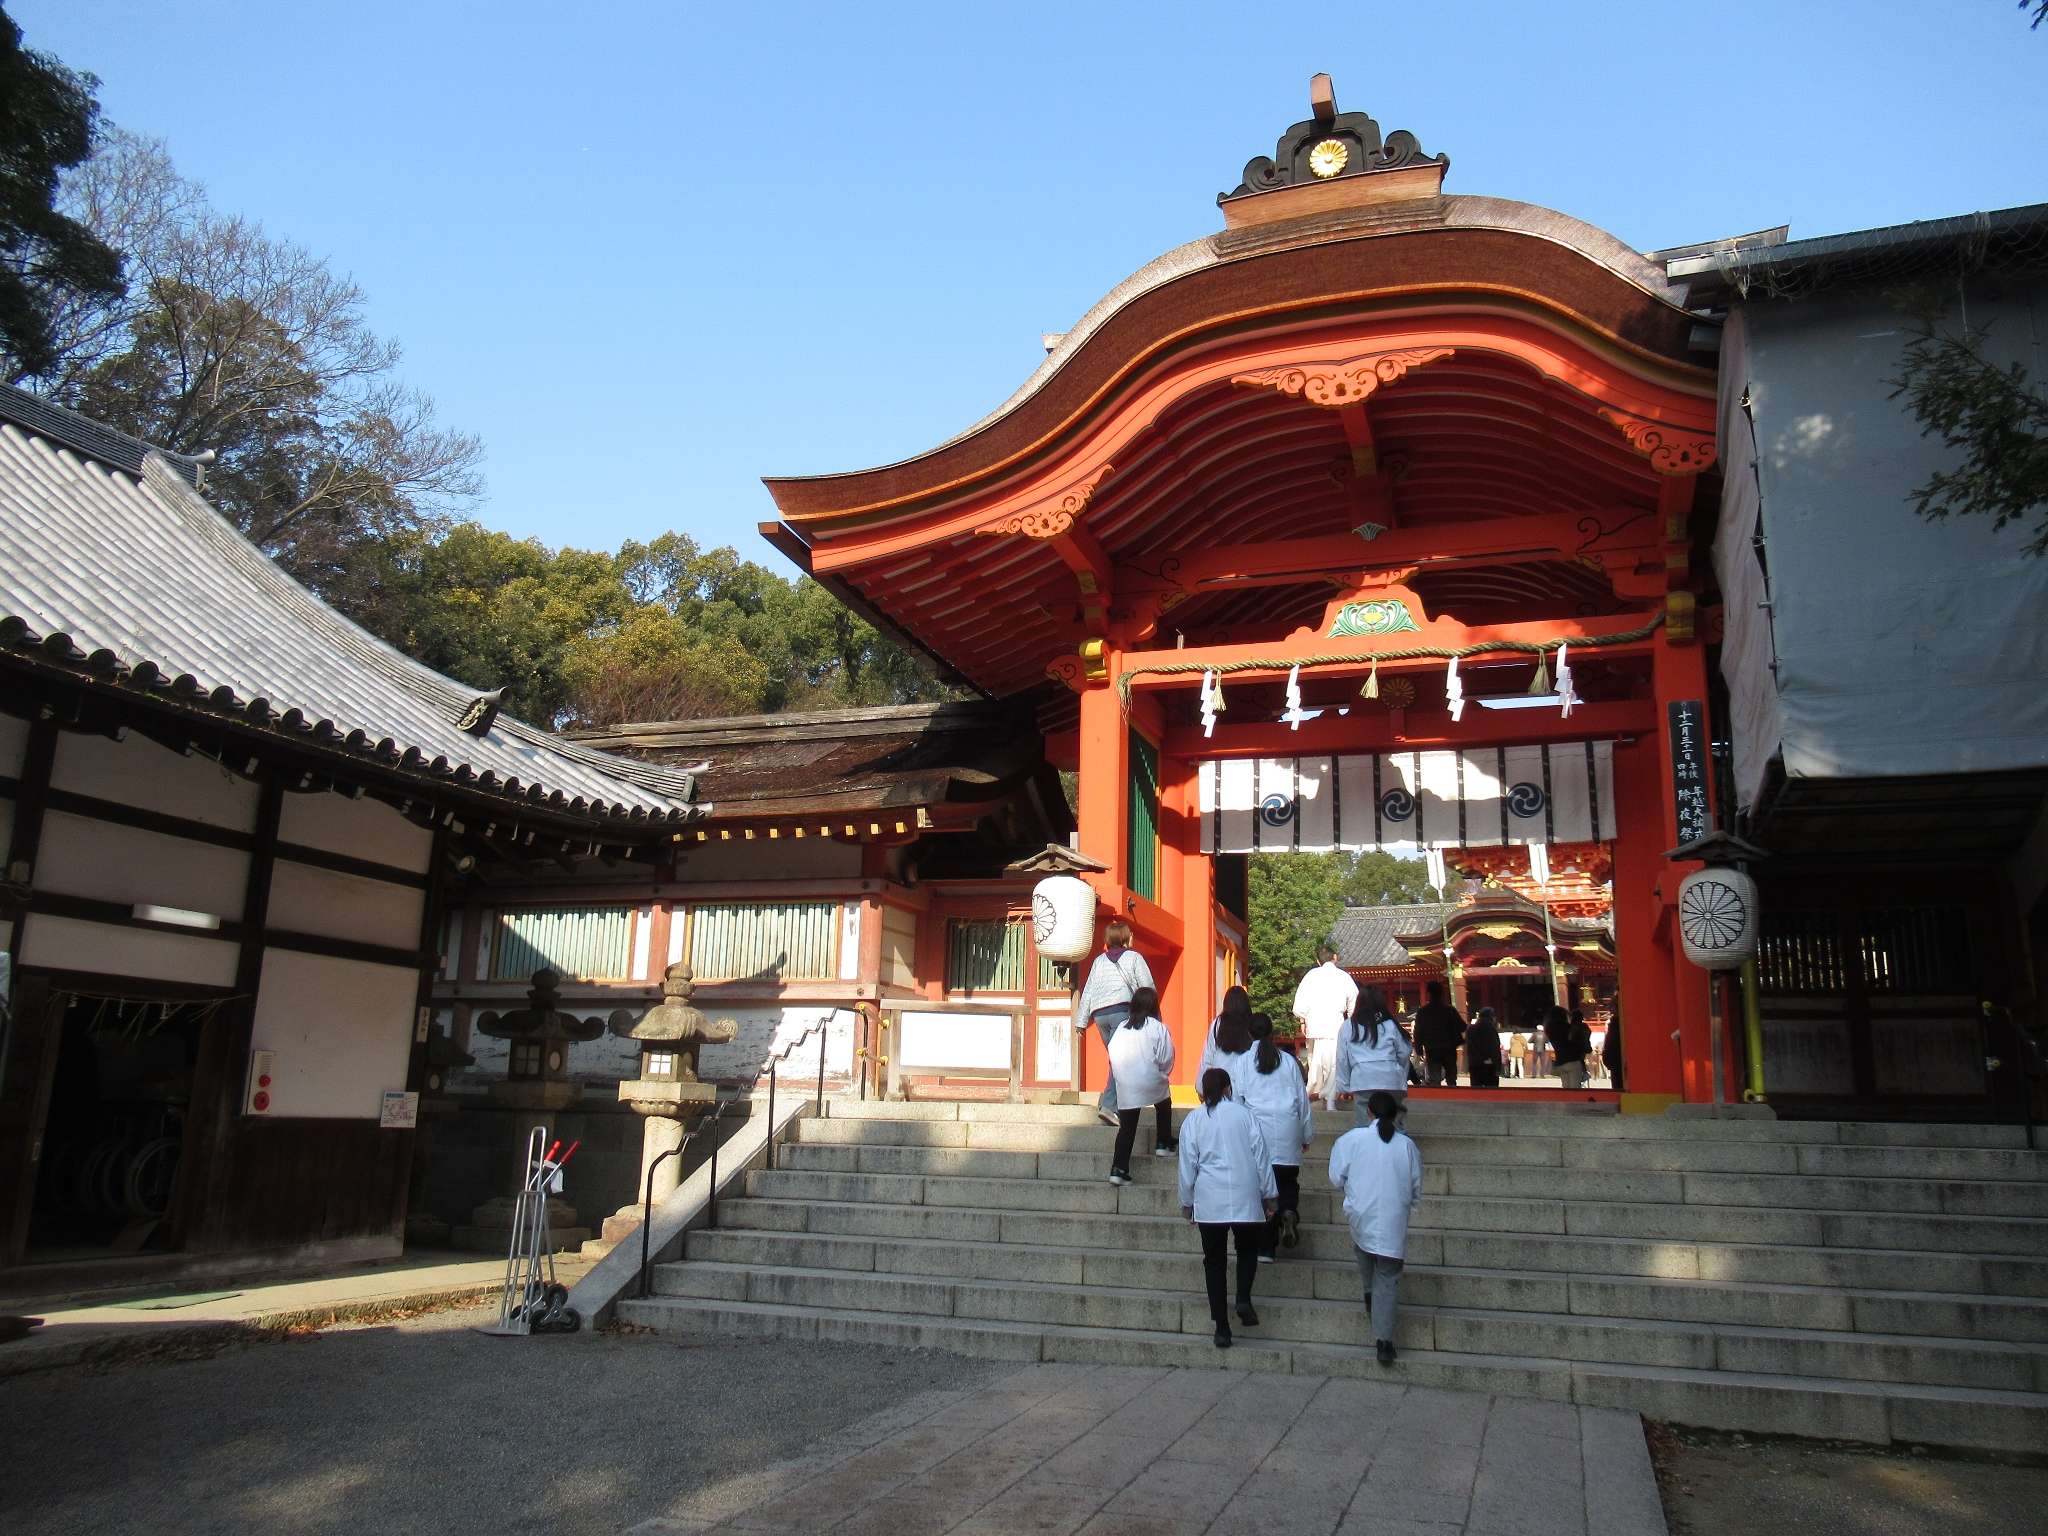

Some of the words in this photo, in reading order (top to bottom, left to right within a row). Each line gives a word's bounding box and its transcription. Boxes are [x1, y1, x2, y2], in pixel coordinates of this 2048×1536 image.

[1678, 710, 1694, 760] 十二月三十一日
[1689, 762, 1699, 779] 午後
[1677, 789, 1693, 840] 除夜祭
